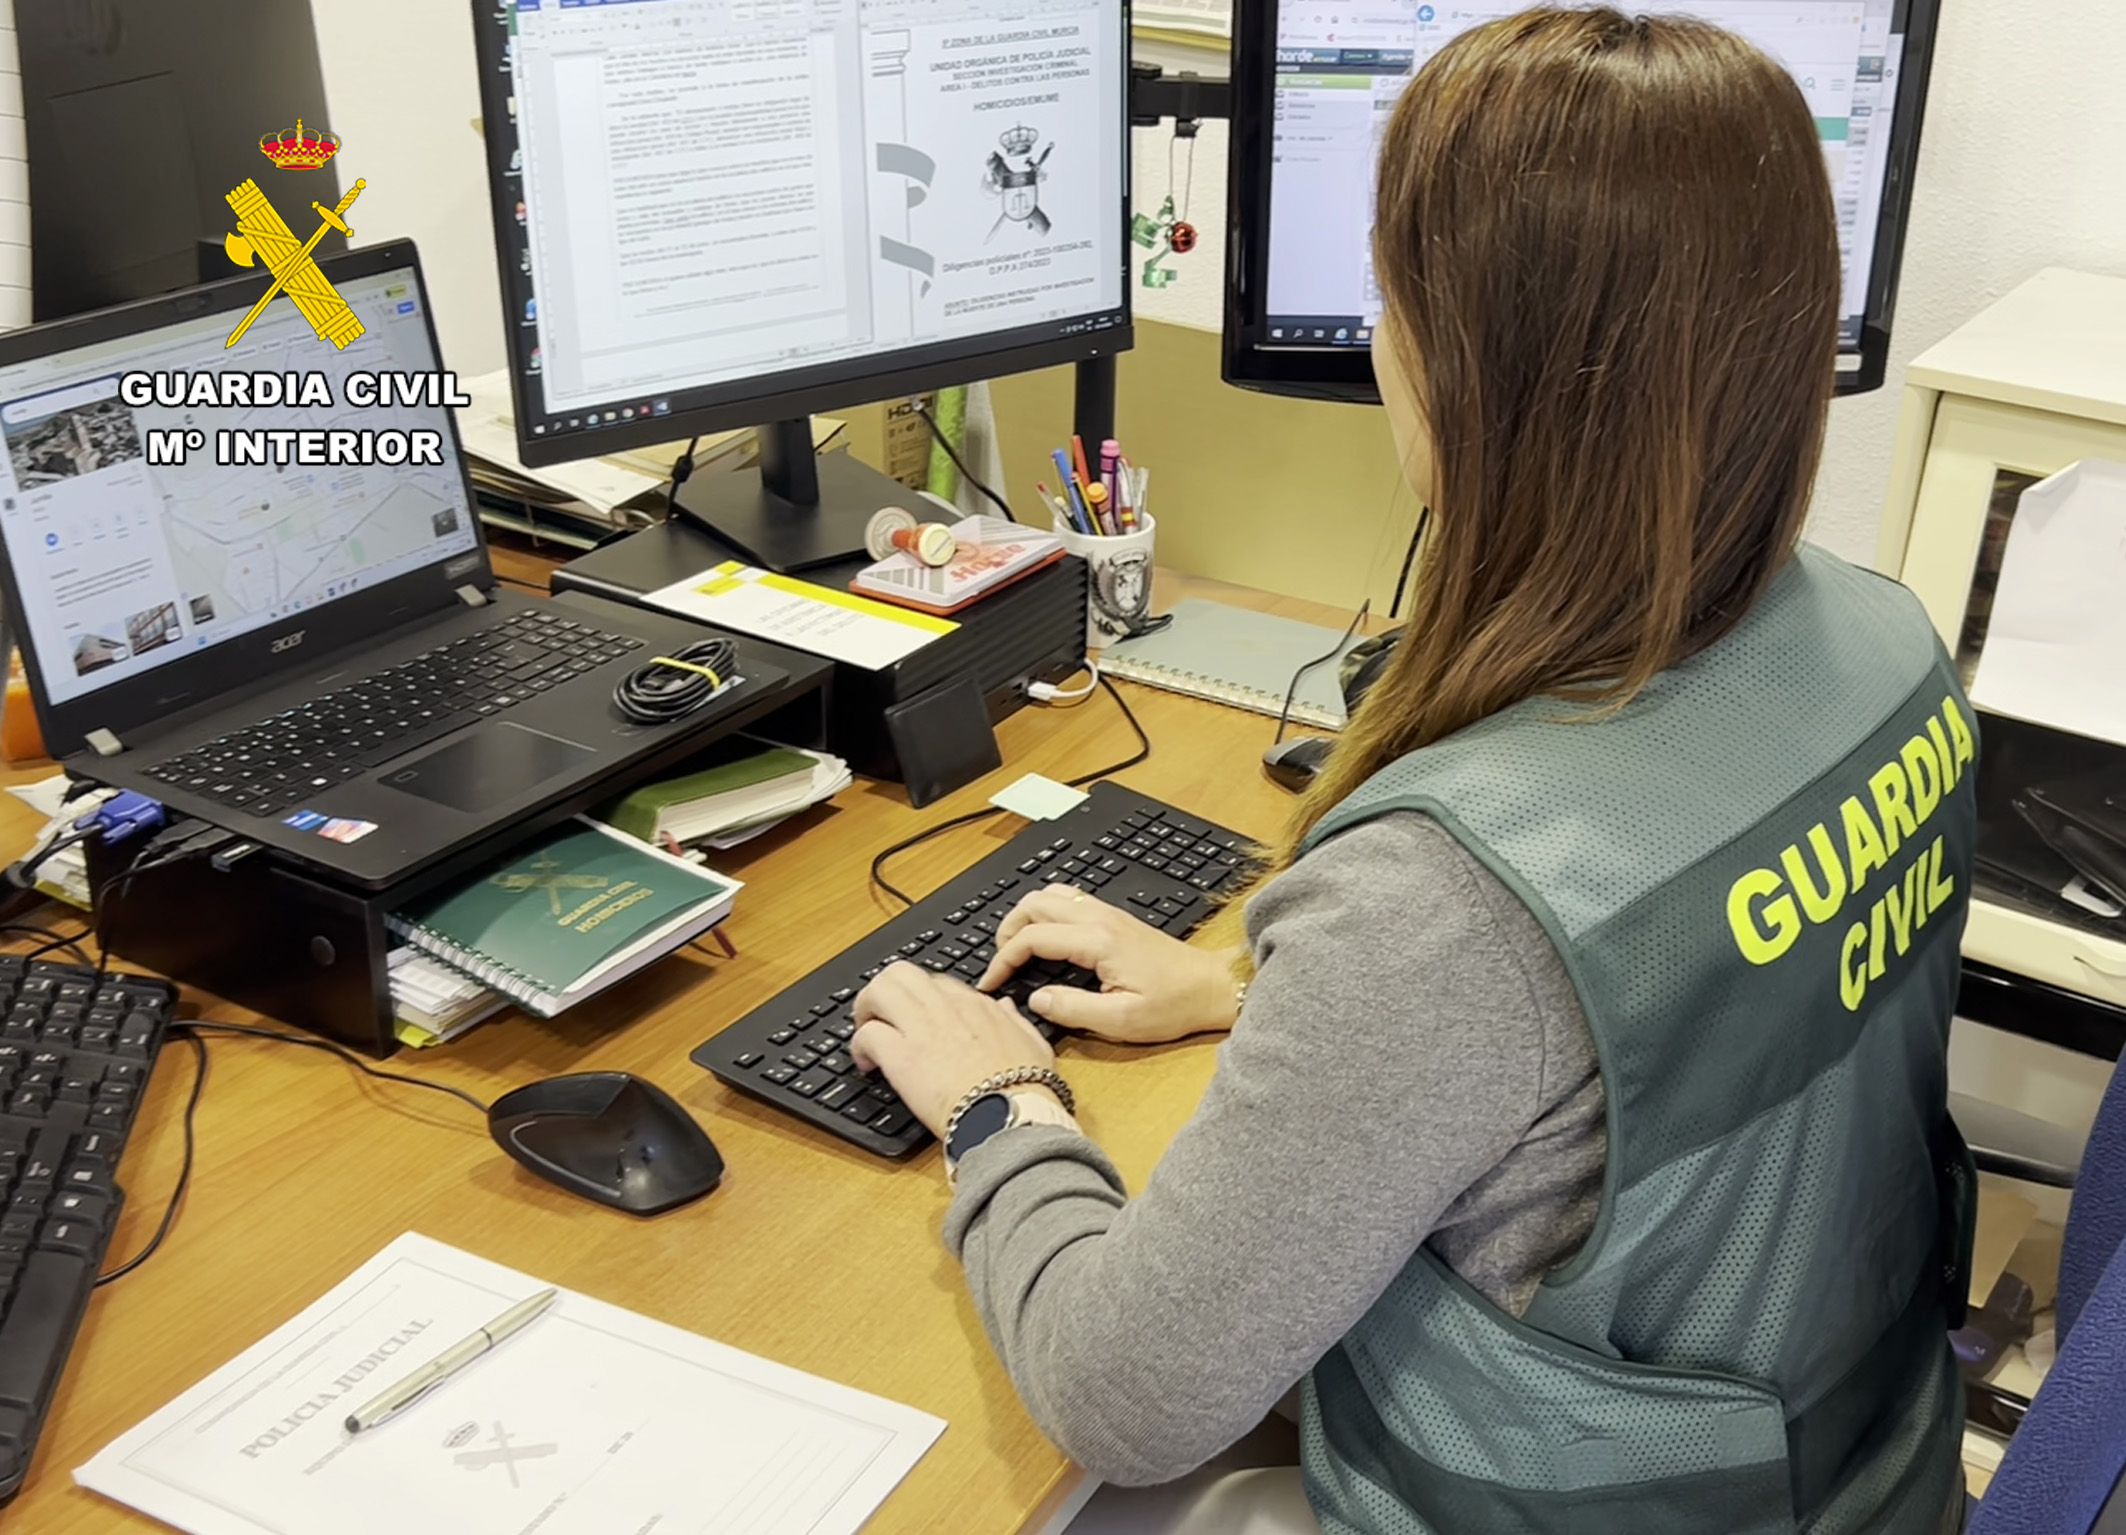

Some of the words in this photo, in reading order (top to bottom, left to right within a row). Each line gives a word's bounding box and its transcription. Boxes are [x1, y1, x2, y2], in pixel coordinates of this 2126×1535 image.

[930, 60, 962, 72] UNIDAD
[1009, 54, 1020, 64] DE
[1056, 46, 1091, 58] JUDICIAL
[271, 630, 306, 653] acer
[1727, 695, 1974, 966] GUARDIA
[1840, 834, 1954, 1011] CIVIL
[334, 1318, 434, 1393] JUDICIAL
